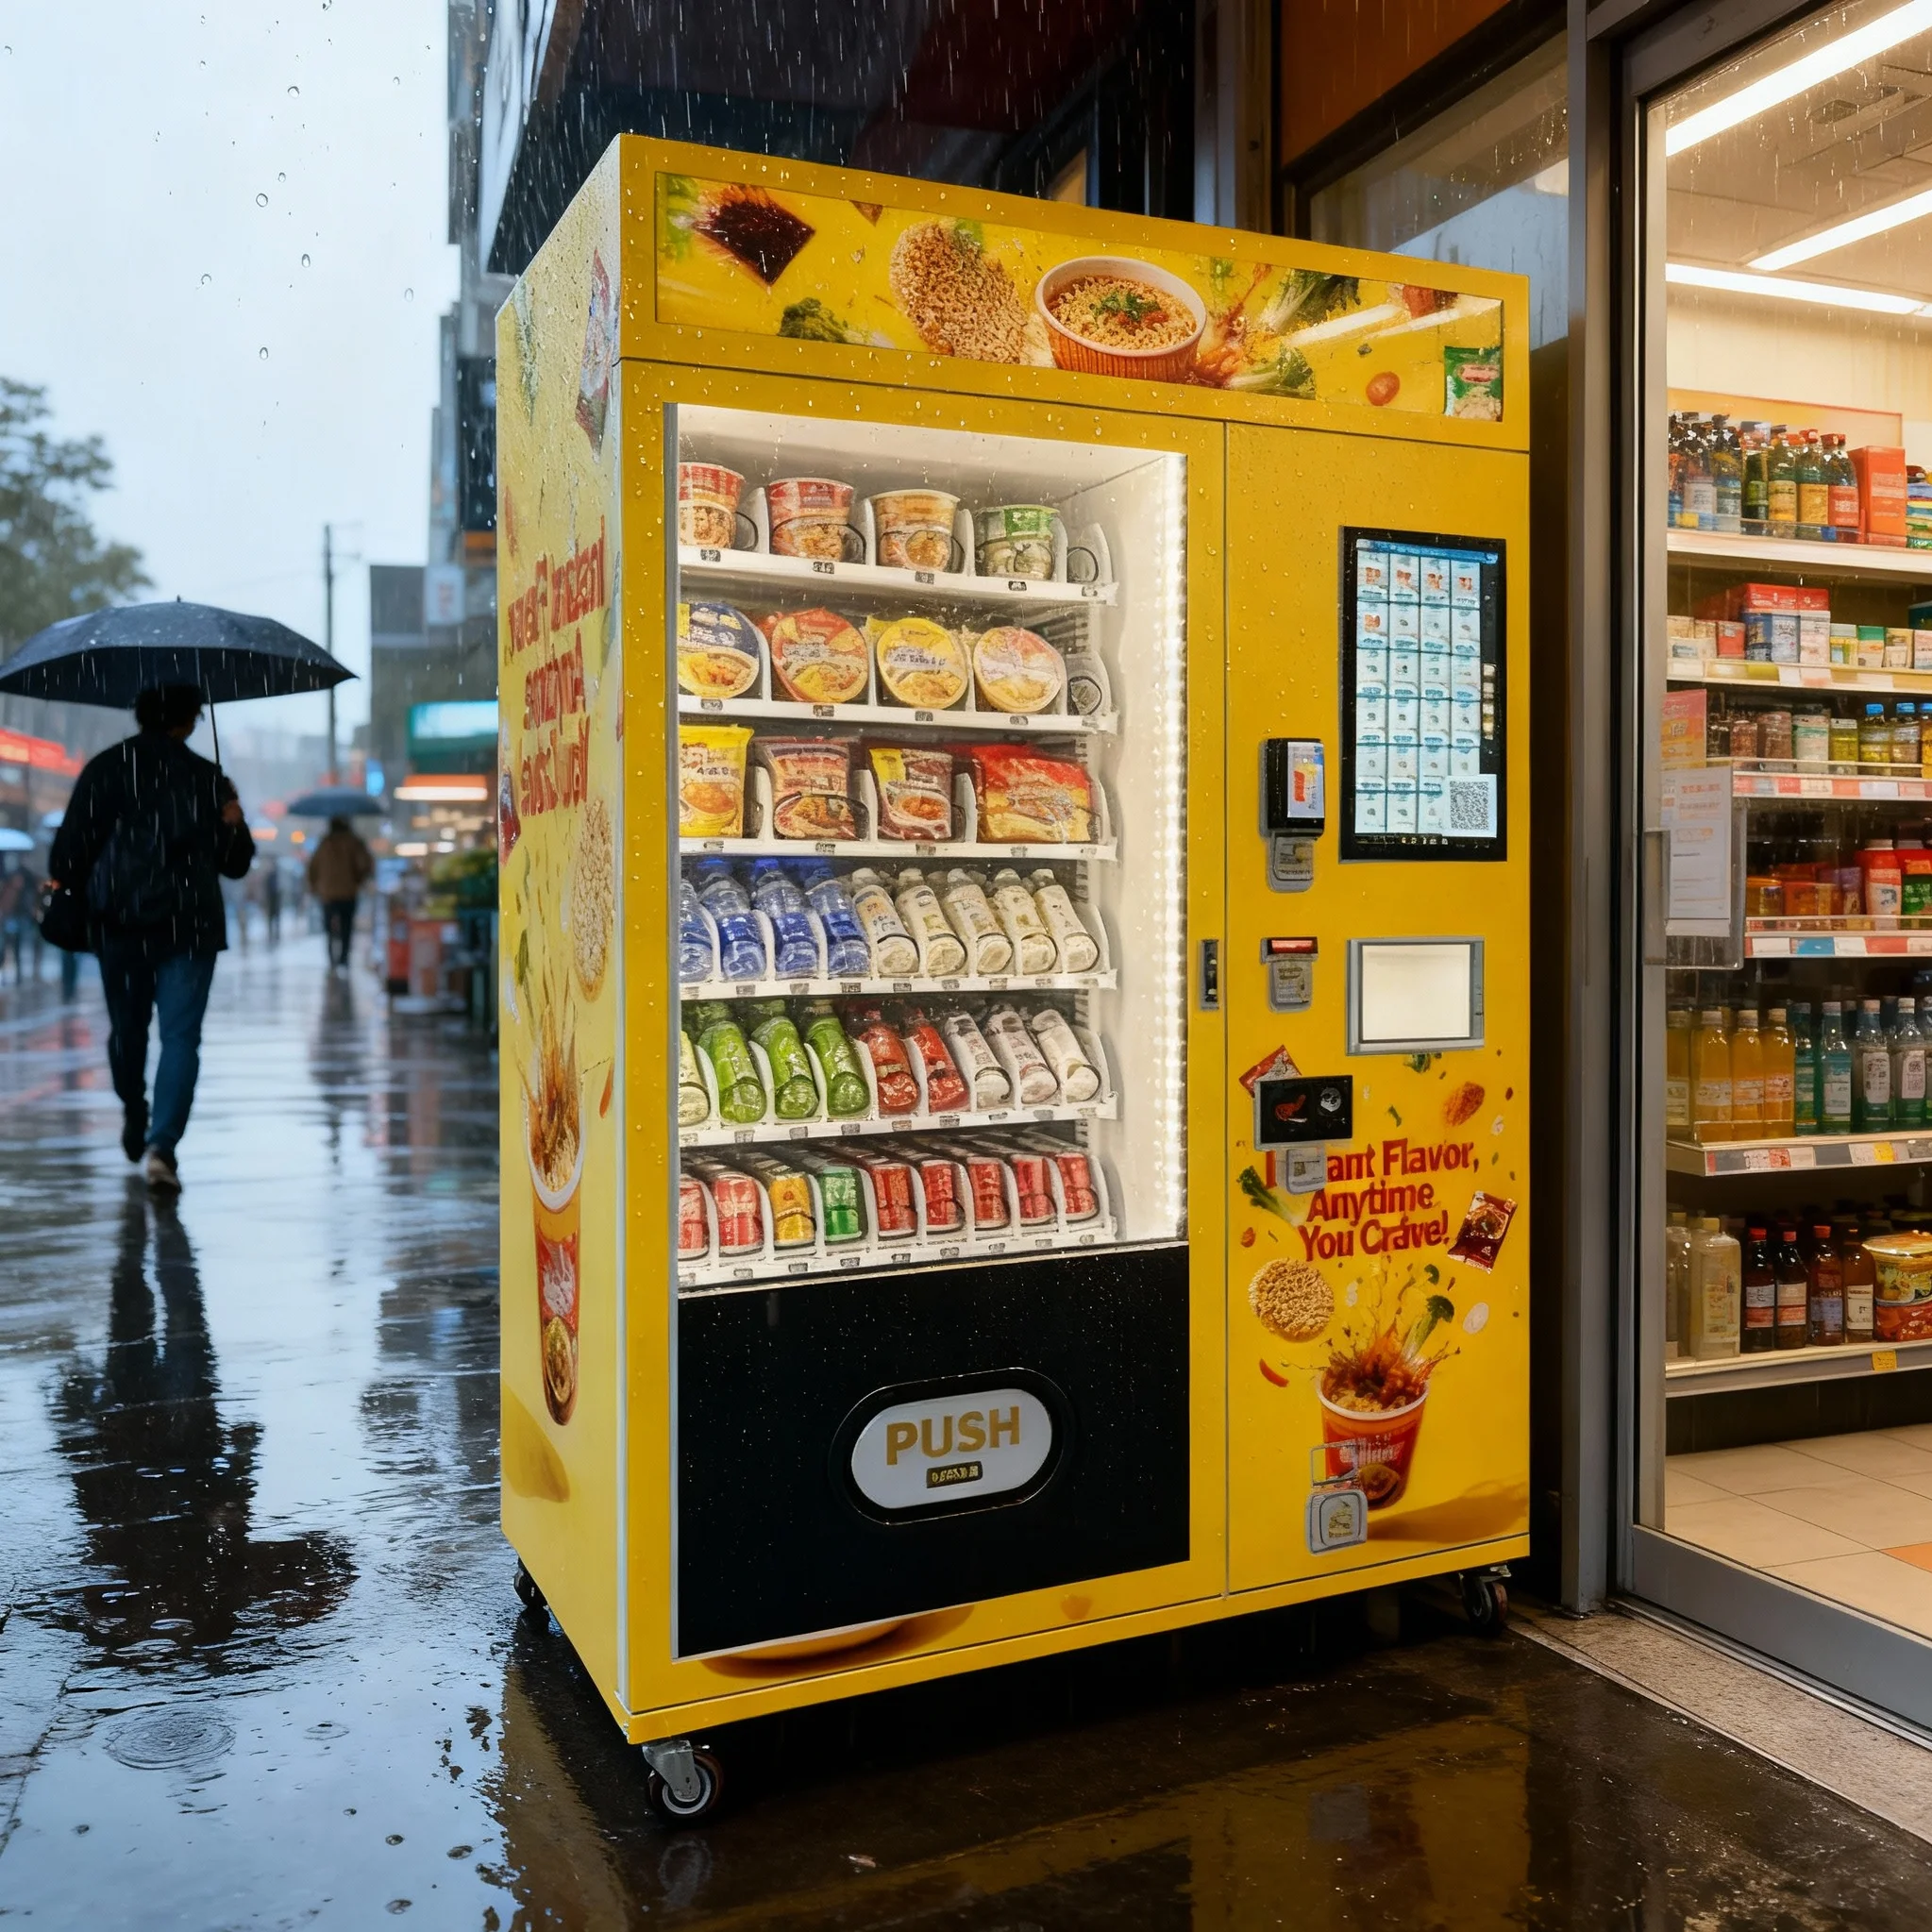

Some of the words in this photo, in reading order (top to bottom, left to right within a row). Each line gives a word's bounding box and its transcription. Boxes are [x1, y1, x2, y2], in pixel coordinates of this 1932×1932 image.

[1383, 1138, 1479, 1176] Flavor,
[1306, 1180, 1435, 1226] Anytime
[1298, 1225, 1354, 1262] You
[1360, 1210, 1450, 1255] Crave!
[886, 1405, 1020, 1466] PUSH
